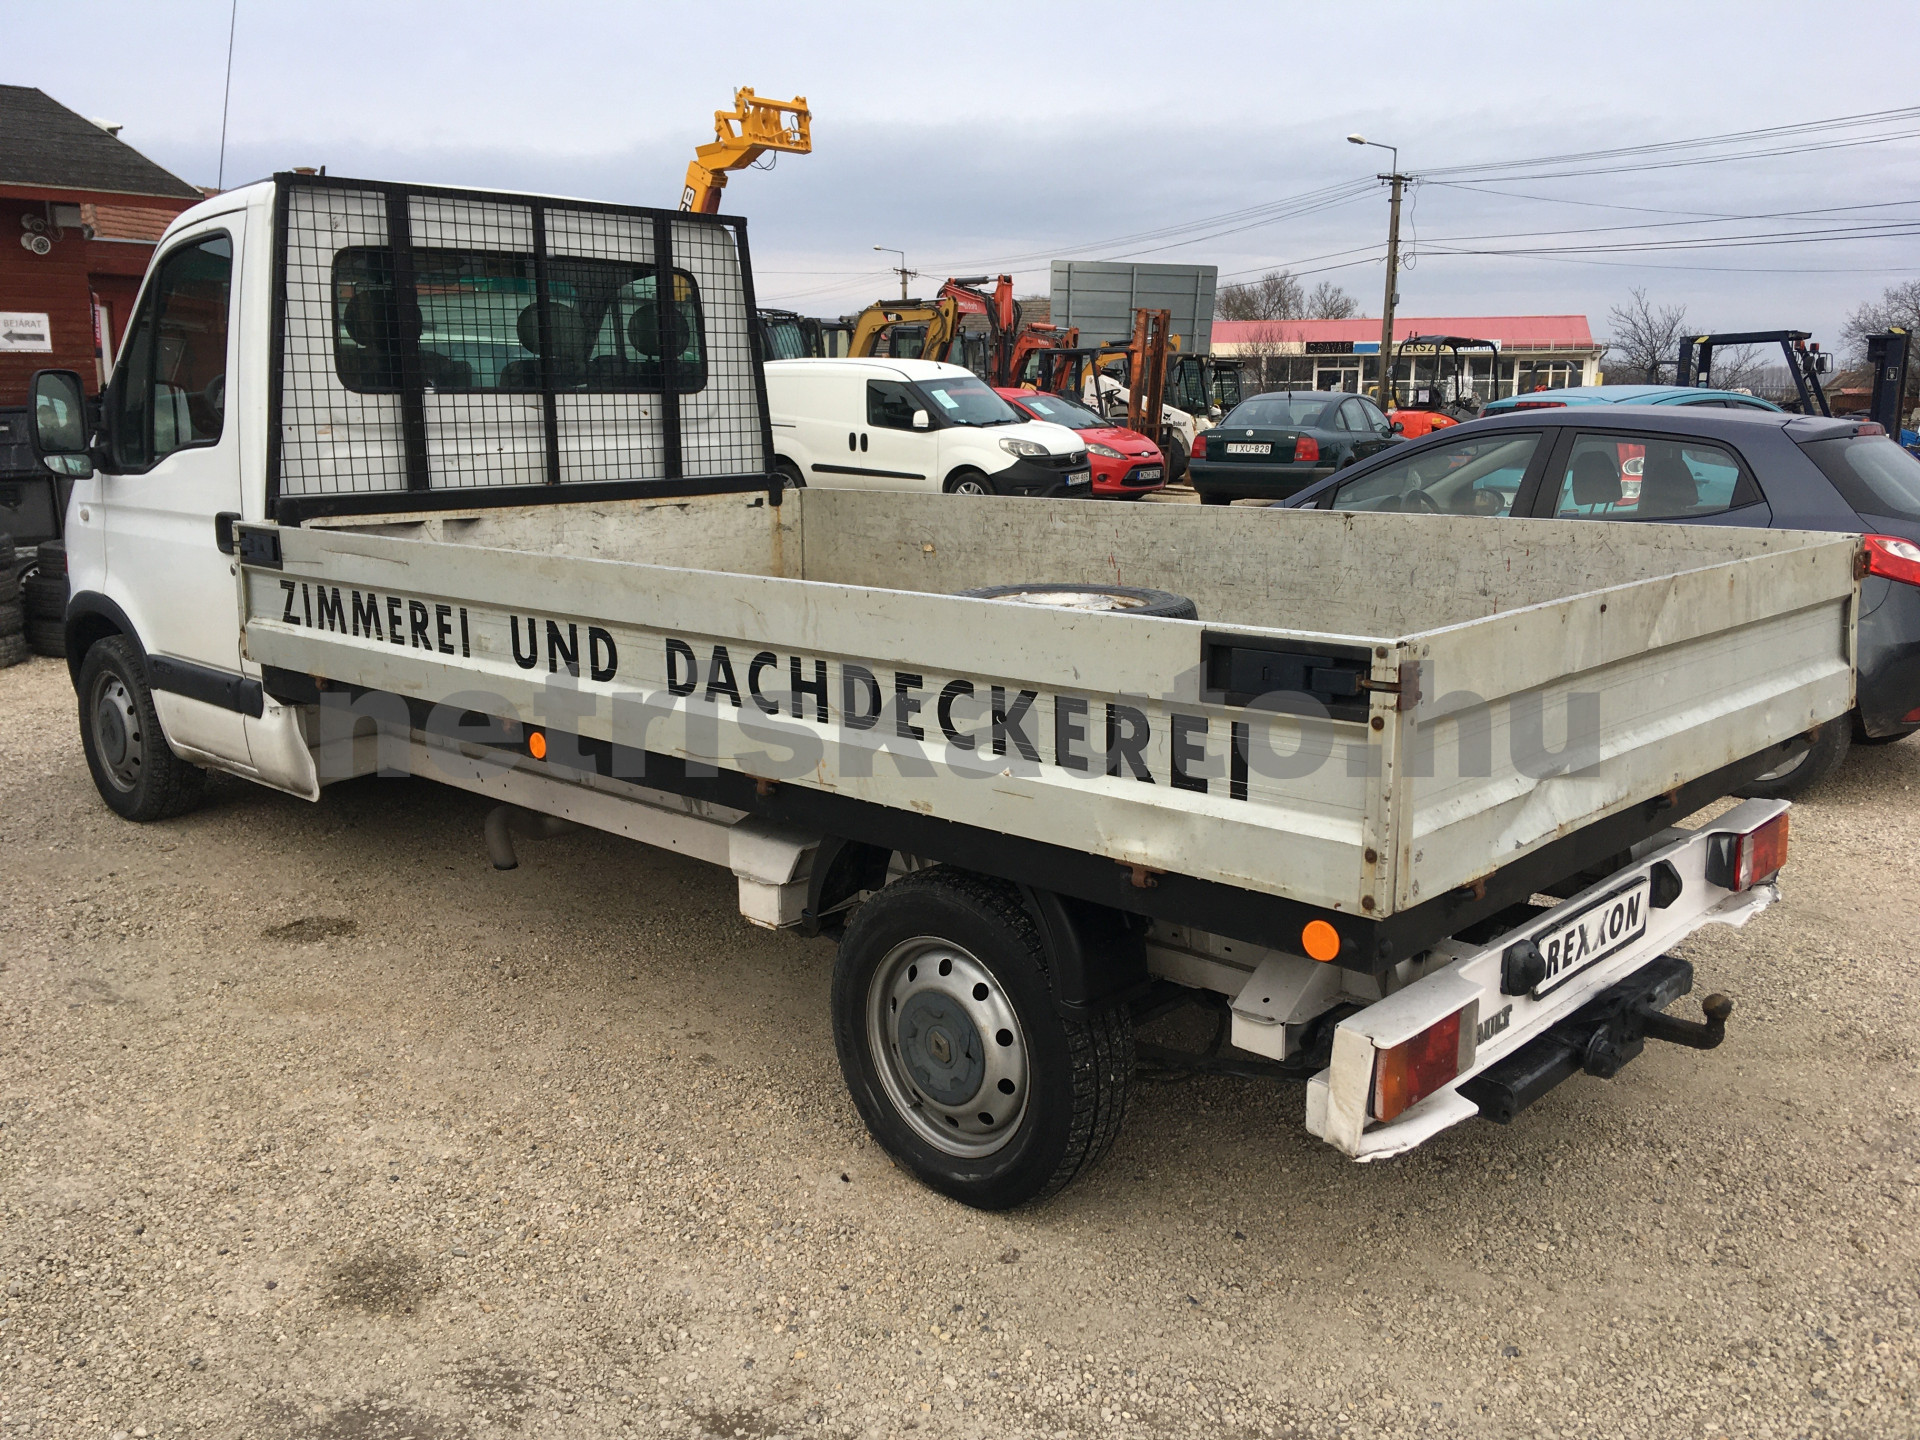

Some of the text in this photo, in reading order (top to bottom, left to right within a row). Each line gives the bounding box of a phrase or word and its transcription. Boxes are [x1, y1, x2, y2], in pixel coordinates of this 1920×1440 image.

[3, 318, 41, 328] BEJÁRAT
[1235, 444, 1270, 453] IXU-828
[279, 580, 1249, 801] ZIMMEREI UND DACHDECKEREI
[1546, 891, 1641, 980] REXXON
[1477, 1003, 1513, 1047] AULT
